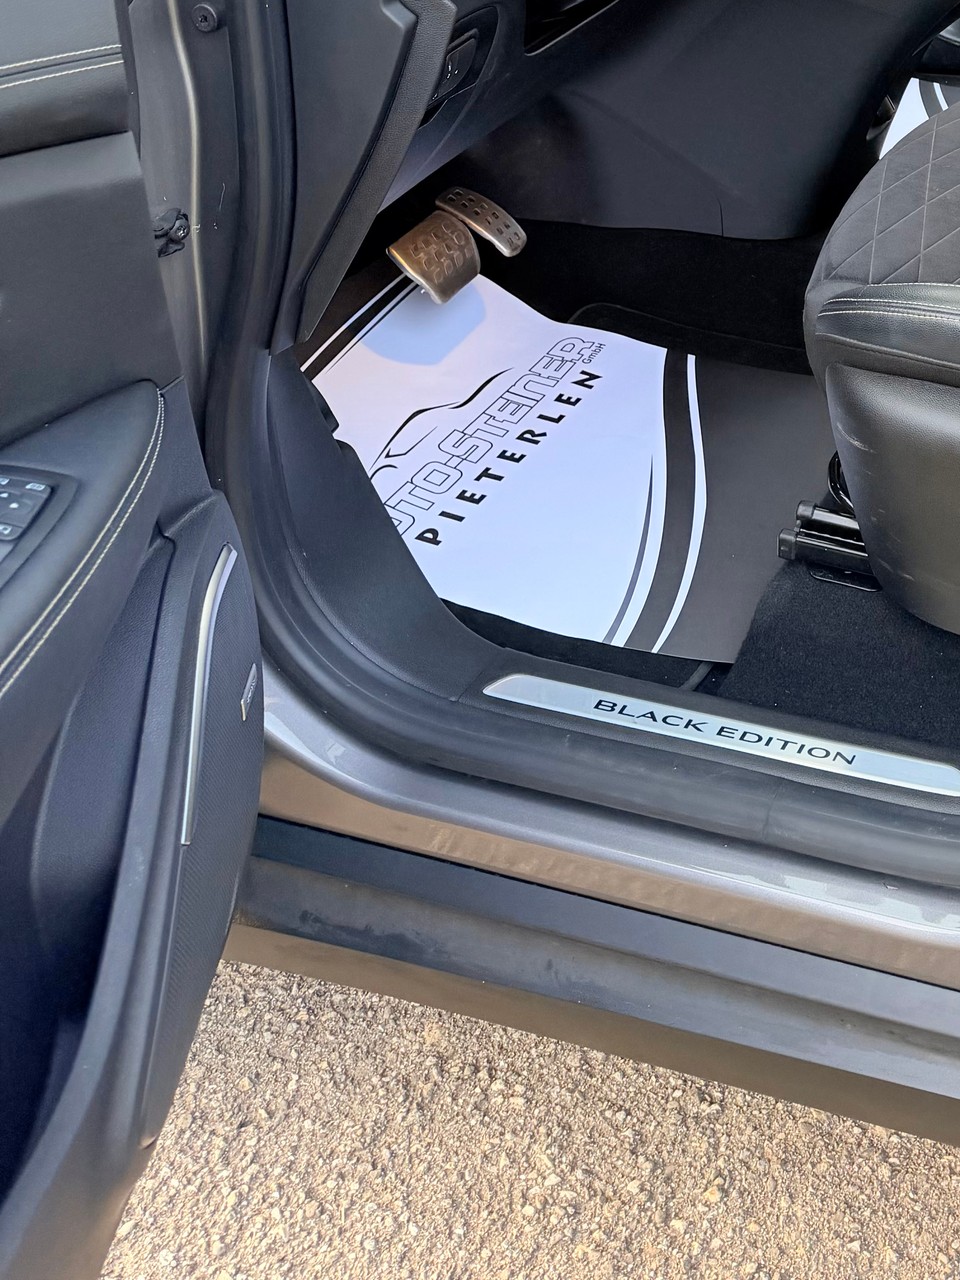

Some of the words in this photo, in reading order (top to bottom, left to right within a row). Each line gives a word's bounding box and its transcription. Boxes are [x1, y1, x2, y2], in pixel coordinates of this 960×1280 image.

[581, 342, 606, 365] GmbH
[414, 369, 603, 546] PIETERLEN
[593, 698, 707, 733] BLACK
[716, 726, 857, 767] EDITION
